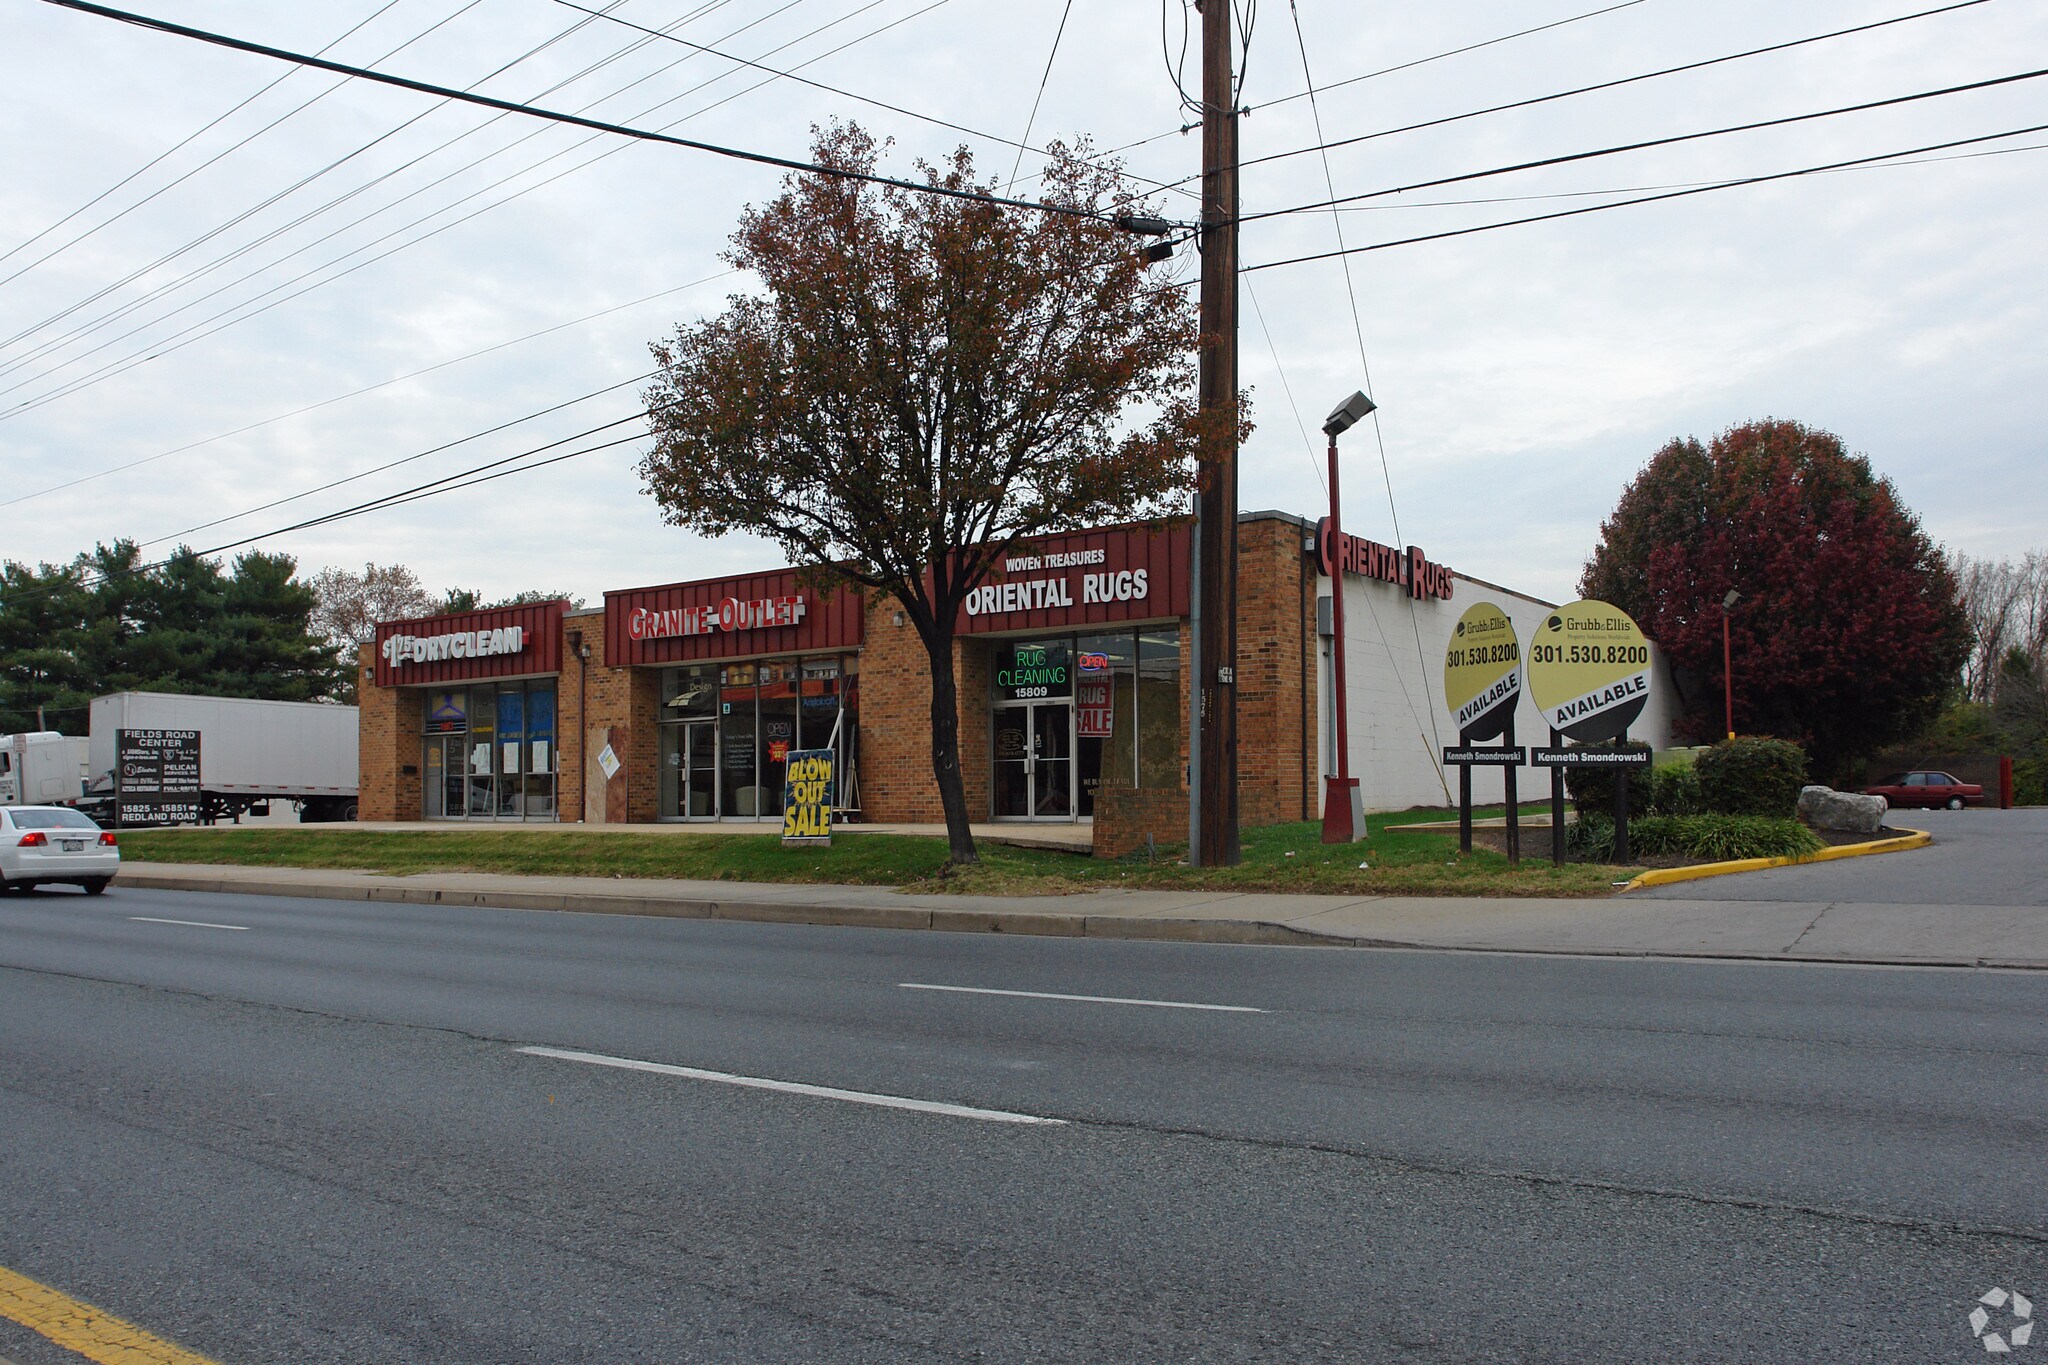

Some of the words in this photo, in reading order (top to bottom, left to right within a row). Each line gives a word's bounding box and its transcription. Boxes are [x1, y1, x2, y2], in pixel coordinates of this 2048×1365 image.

[1006, 555, 1041, 572] WOVEN
[1045, 549, 1105, 569] TREASURES
[1407, 545, 1454, 600] RUGS
[965, 577, 1073, 616] ORIENTAL
[1083, 568, 1148, 604] RUGS
[628, 607, 713, 641] GRANITE
[718, 596, 802, 633] OUTLET
[414, 625, 523, 663] DRYCLEAN
[1016, 650, 1046, 667] RUG
[1079, 655, 1108, 668] OPEN
[1447, 642, 1517, 668] 301.530.8200
[1533, 645, 1648, 664] 301.530.8200
[998, 667, 1066, 687] CLEANING
[690, 682, 713, 693] Design
[1015, 686, 1048, 698] 15809
[1079, 687, 1106, 704] RUG
[1459, 673, 1518, 724] AVAILABLE
[1557, 675, 1647, 724] AVAILABLE
[125, 730, 163, 739] FIELDS
[165, 731, 196, 739] ROAD
[767, 722, 791, 735] OPEN
[138, 739, 182, 747] CENTER
[1446, 751, 1474, 761] Kenneth
[1475, 751, 1521, 761] Smondrowski
[1537, 752, 1579, 762] Kenneth
[1580, 752, 1647, 762] Smondrowski
[788, 757, 832, 782] BLOW
[794, 781, 826, 804] OUT
[122, 804, 151, 812] 15825
[161, 804, 187, 812] 15851
[122, 813, 168, 821] REDLAND
[170, 812, 197, 820] ROAD
[784, 805, 831, 837] SALE
